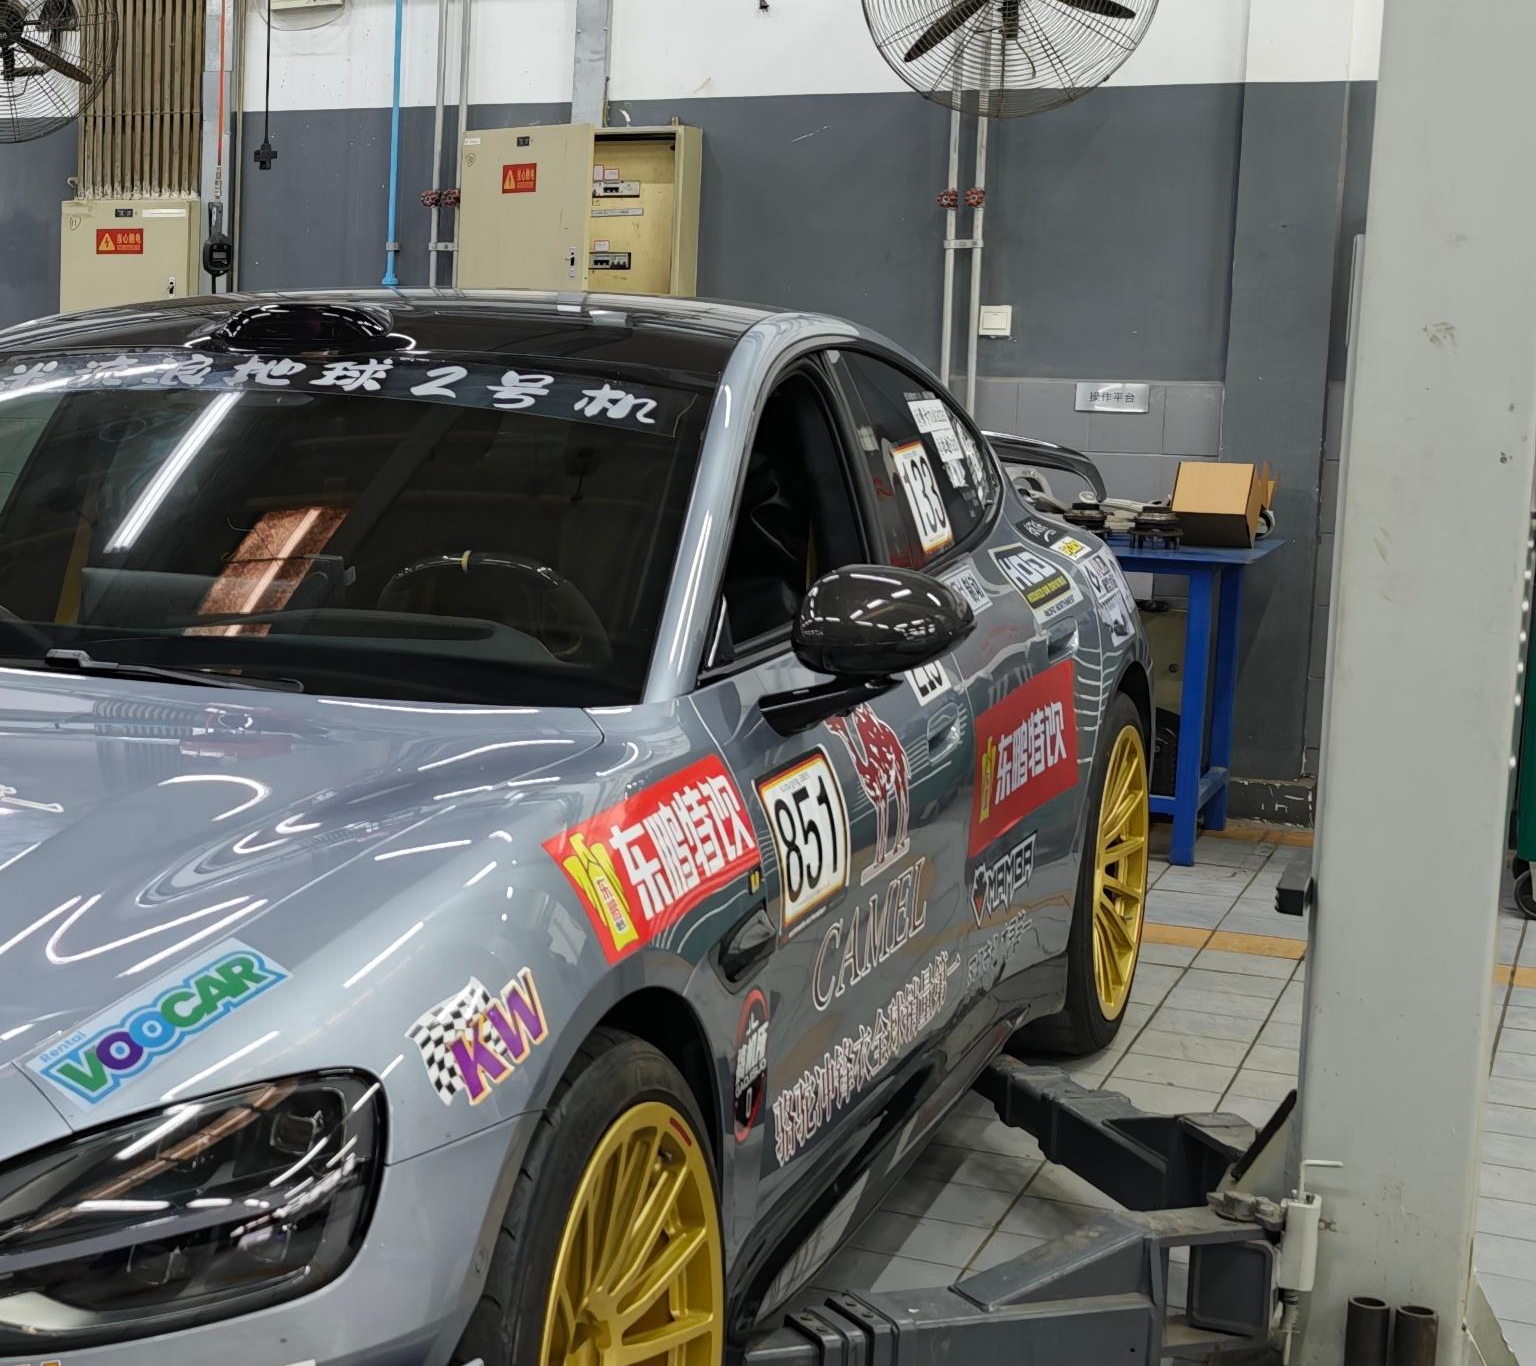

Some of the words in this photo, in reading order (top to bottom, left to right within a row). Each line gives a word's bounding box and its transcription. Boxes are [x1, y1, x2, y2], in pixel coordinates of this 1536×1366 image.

[902, 454, 947, 537] 133
[995, 701, 1067, 805] 东鹏特饮
[609, 775, 756, 921] 东鹏特饮
[774, 774, 838, 903] 851
[812, 856, 927, 1011] CAMEL
[56, 956, 269, 1093] VOOCAR
[448, 967, 548, 1105] KW
